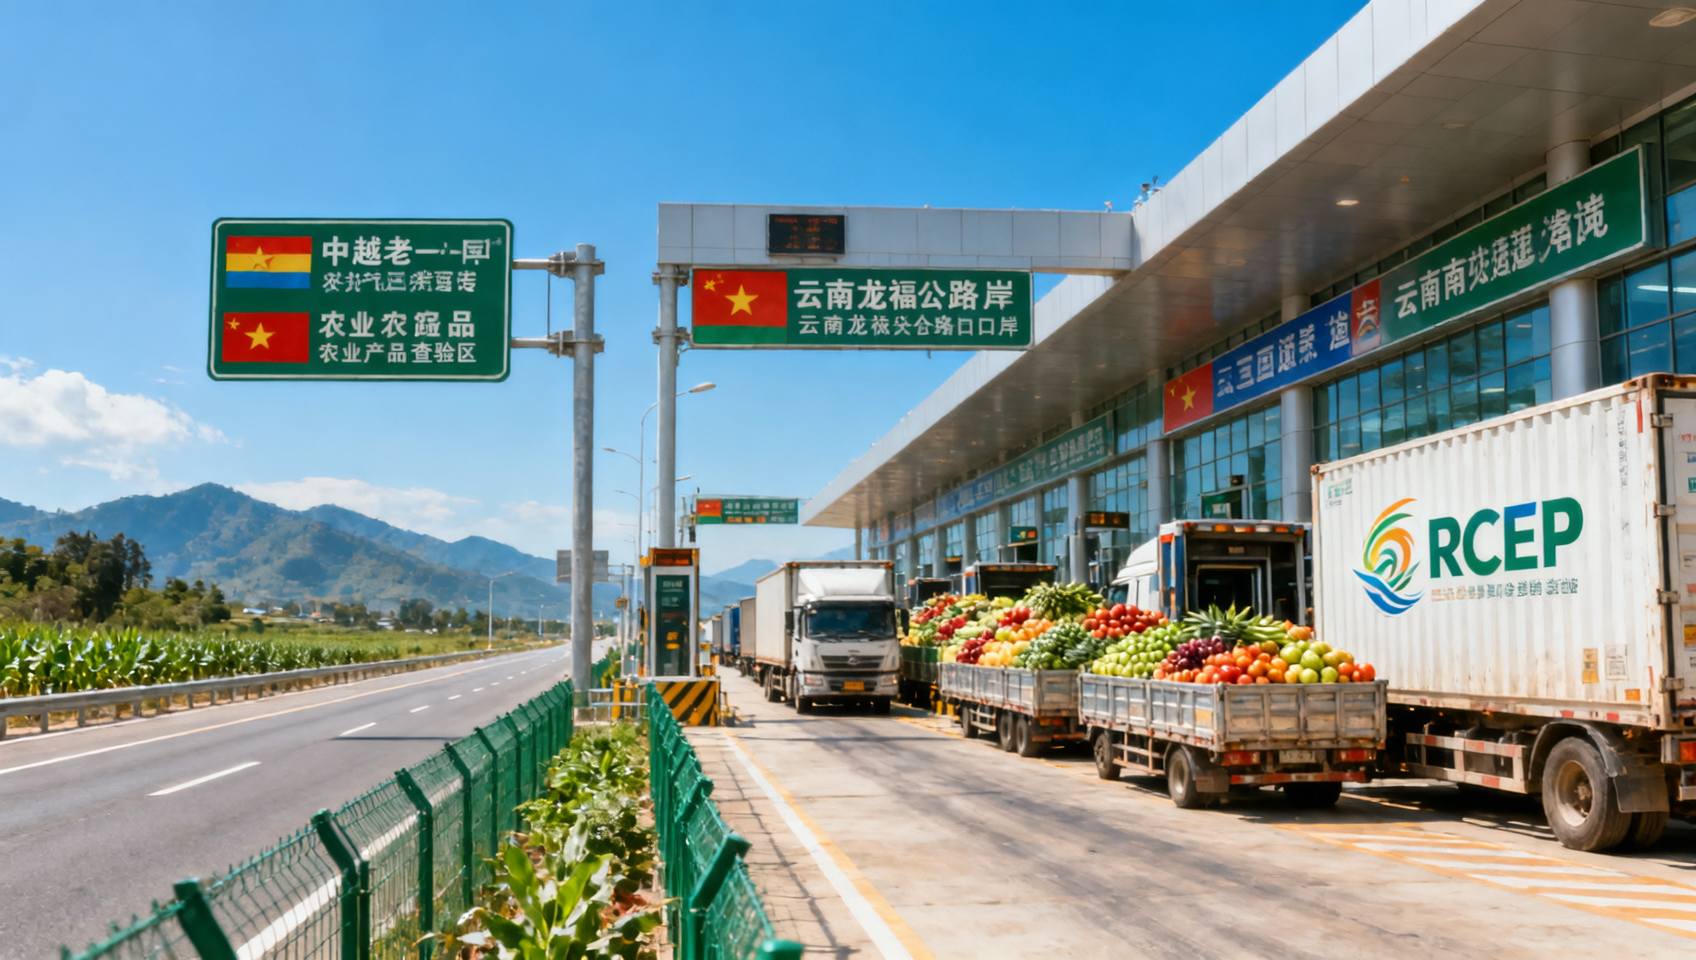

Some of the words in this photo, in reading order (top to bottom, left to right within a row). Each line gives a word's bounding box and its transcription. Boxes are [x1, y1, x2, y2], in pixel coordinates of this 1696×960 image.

[793, 278, 1014, 311] 云南龙福公路岸
[318, 341, 477, 364] 农业产品查验区
[1429, 497, 1585, 578] RCEP
